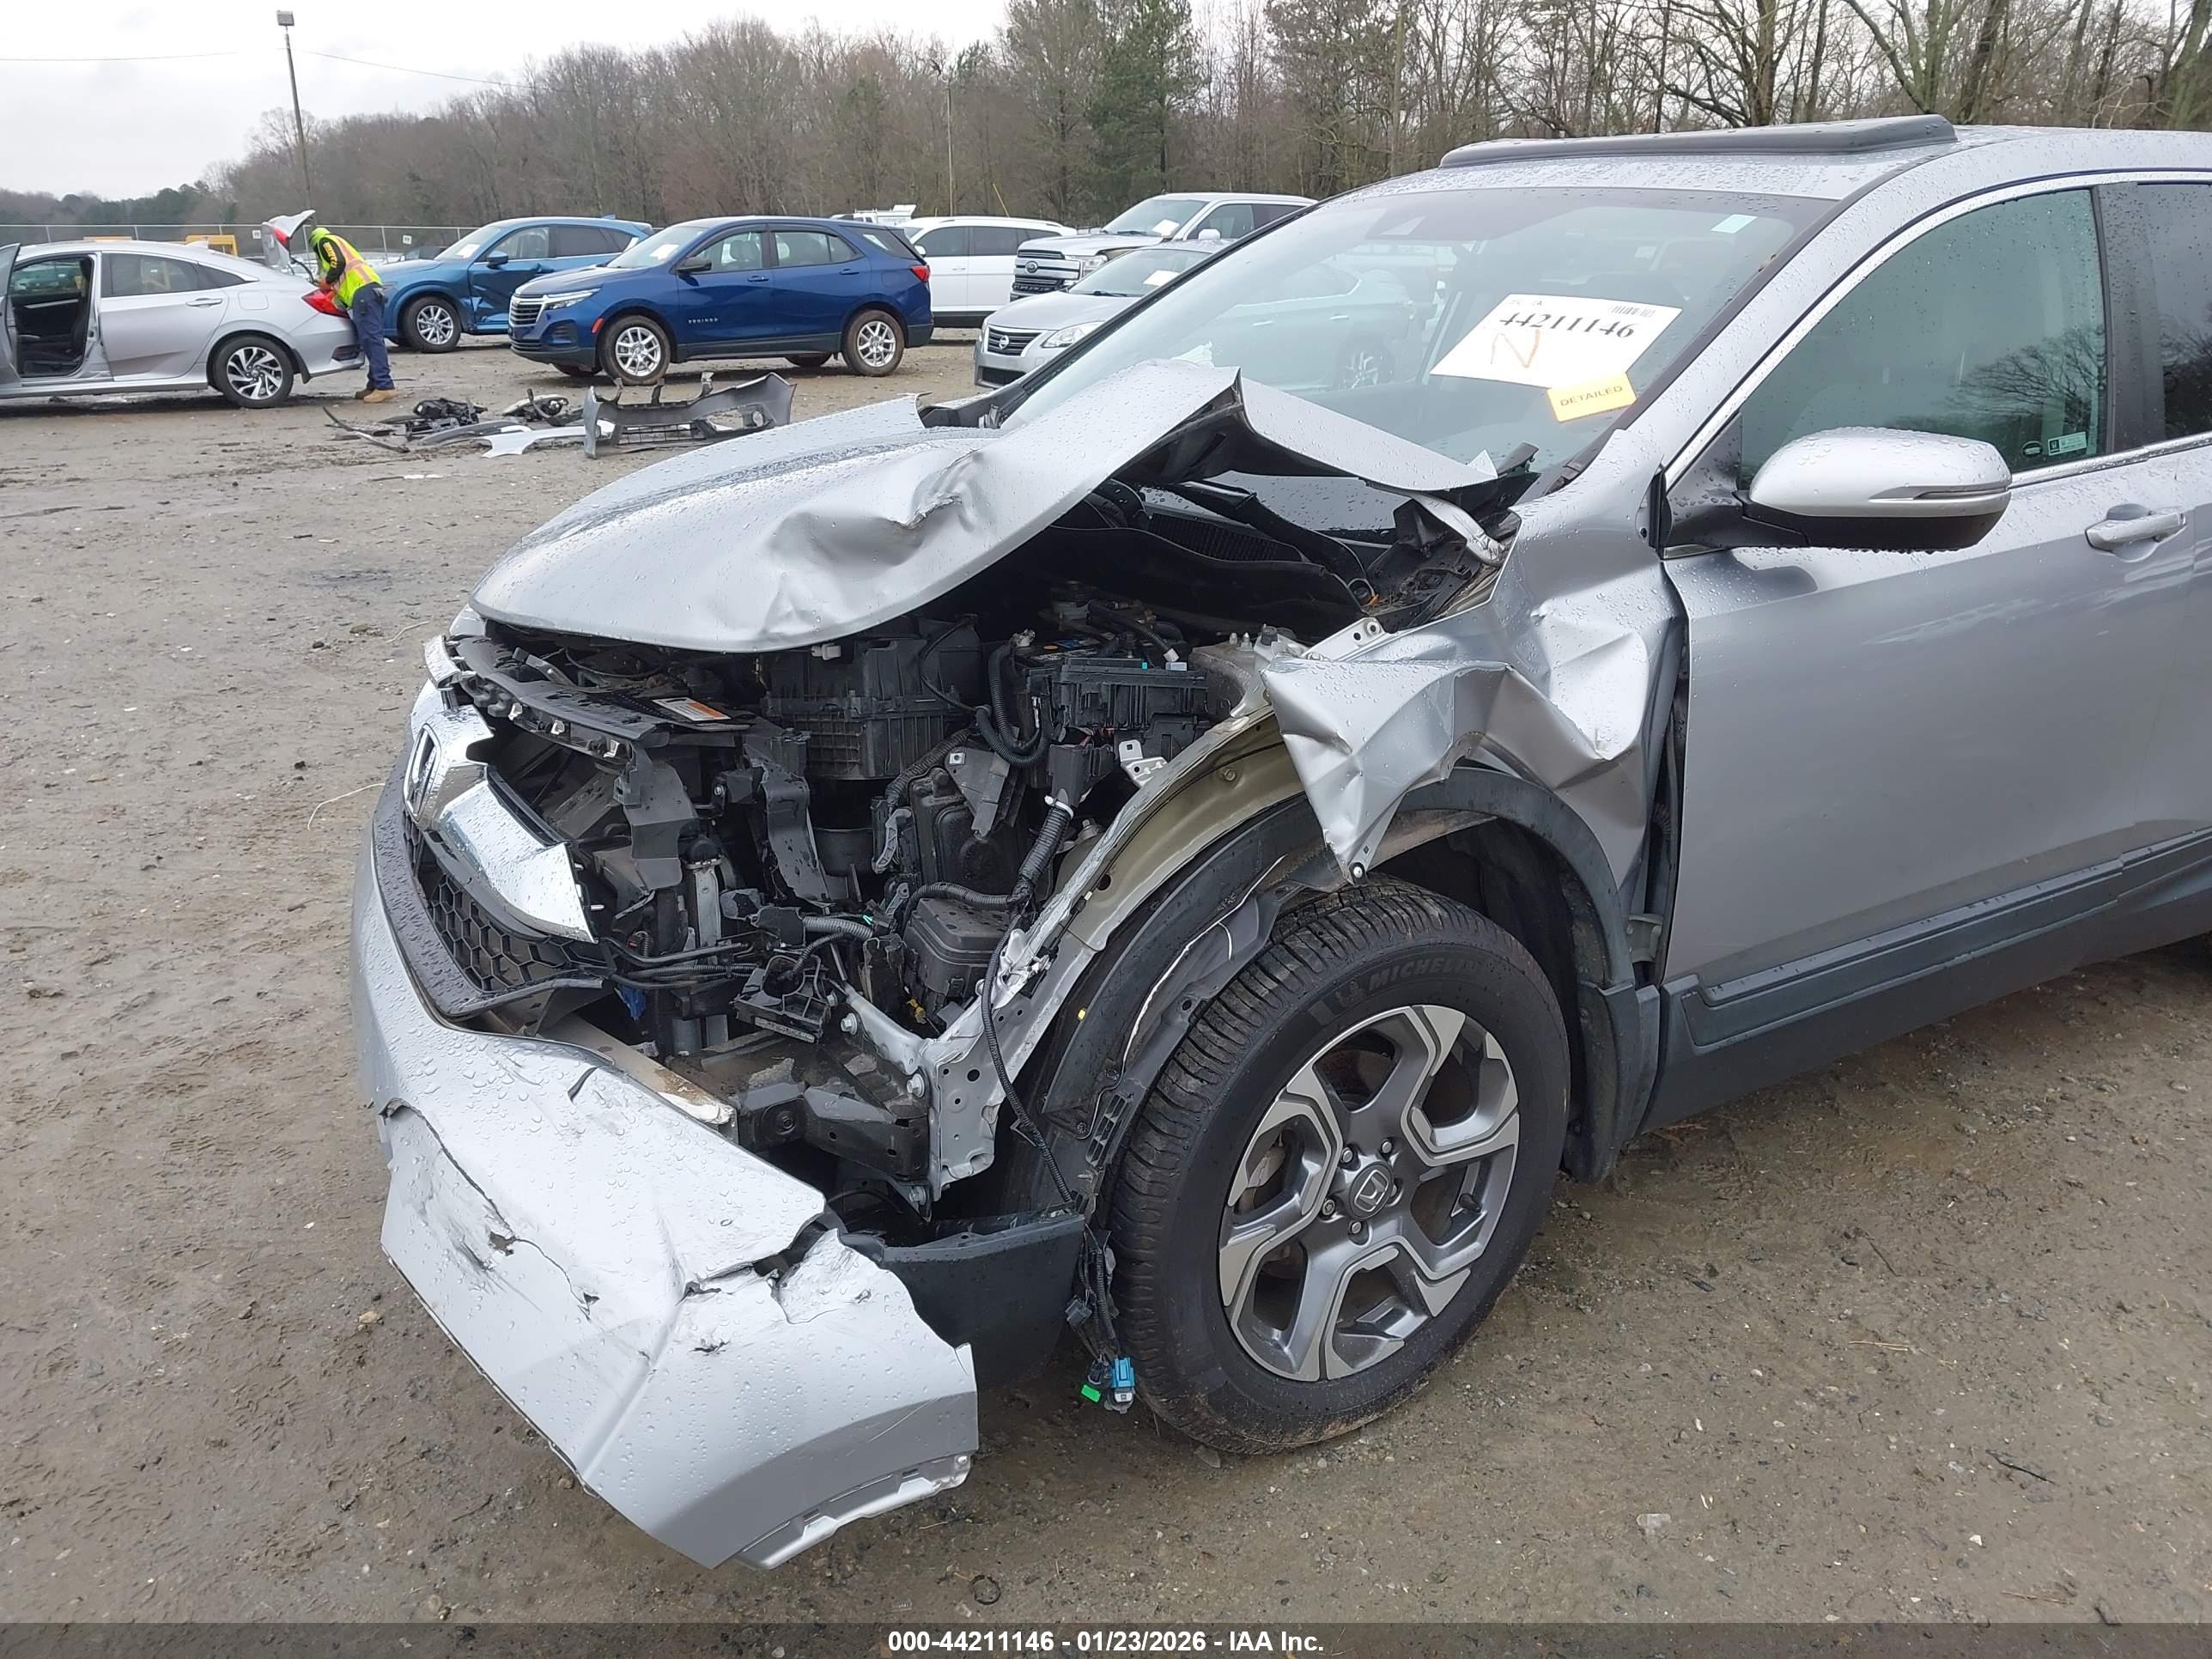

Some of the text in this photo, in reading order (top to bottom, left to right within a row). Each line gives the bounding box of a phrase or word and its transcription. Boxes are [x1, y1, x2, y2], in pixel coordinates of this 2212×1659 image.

[1499, 312, 1639, 338] 44211146
[1559, 386, 1624, 406] DETAILED
[1368, 957, 1479, 991] MICHELIN
